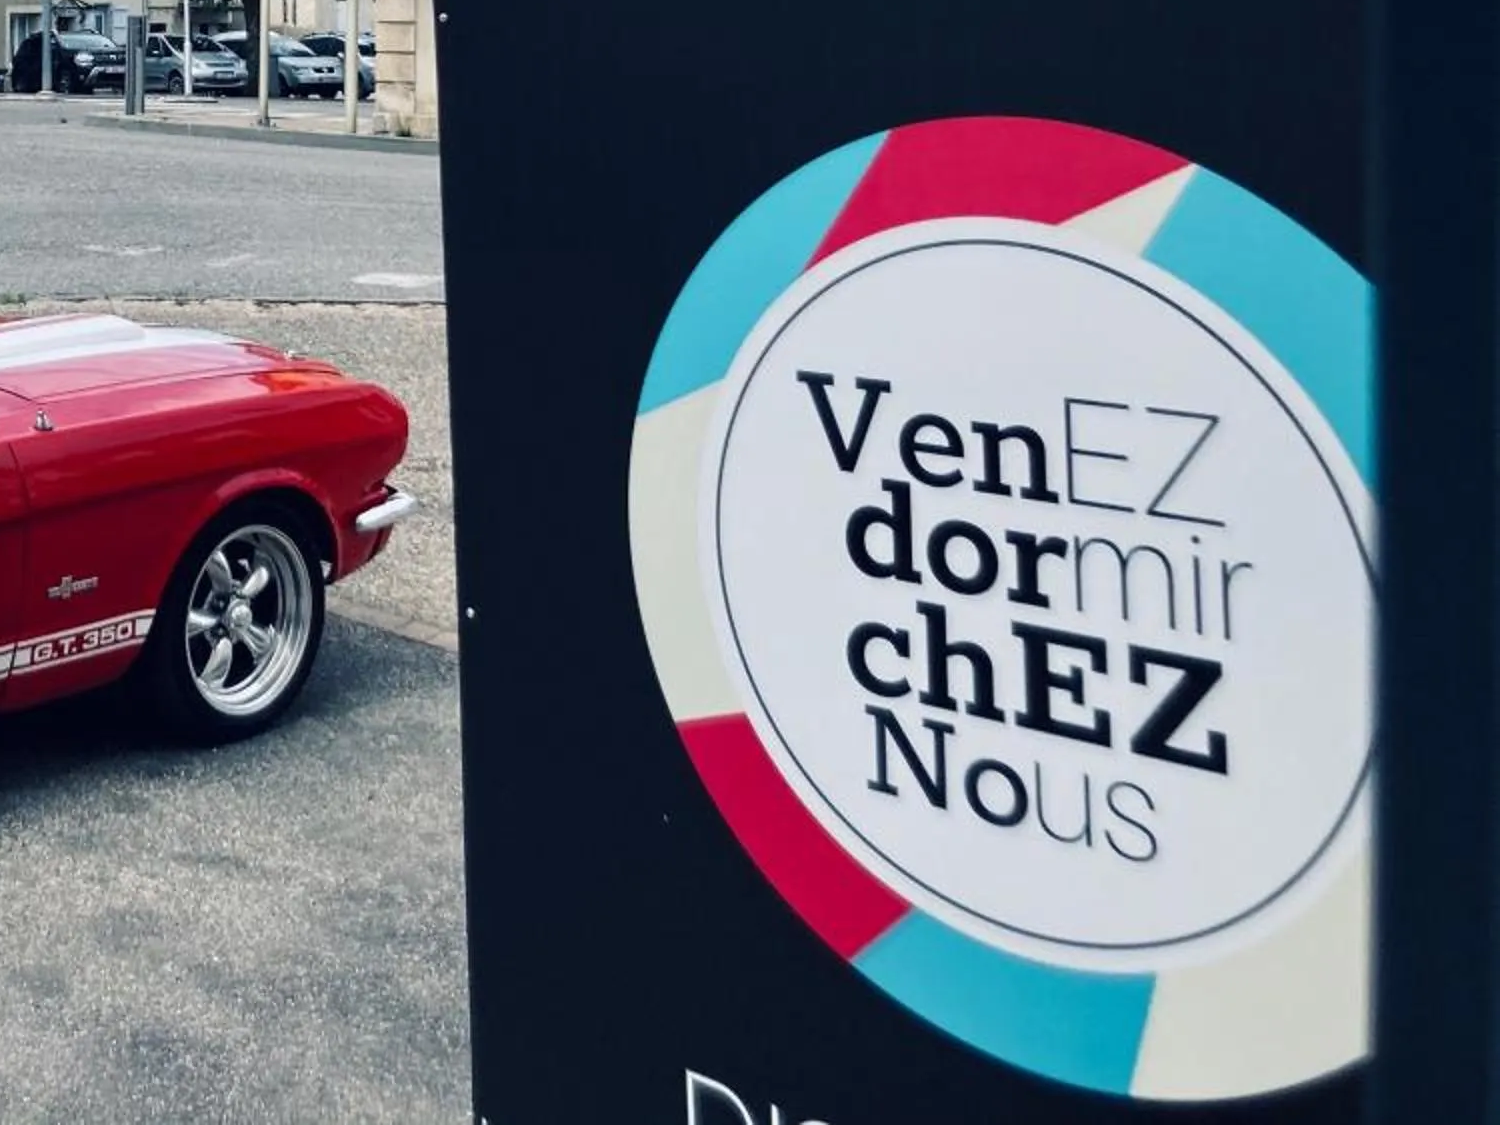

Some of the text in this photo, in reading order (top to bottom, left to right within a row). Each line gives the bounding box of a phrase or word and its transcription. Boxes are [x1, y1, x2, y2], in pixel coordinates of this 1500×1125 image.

[796, 369, 1227, 528] VenEZ
[845, 479, 1256, 641] dormir
[33, 621, 133, 662] G.T. 350
[846, 600, 1230, 776] chEZ
[864, 704, 1159, 864] Nous
